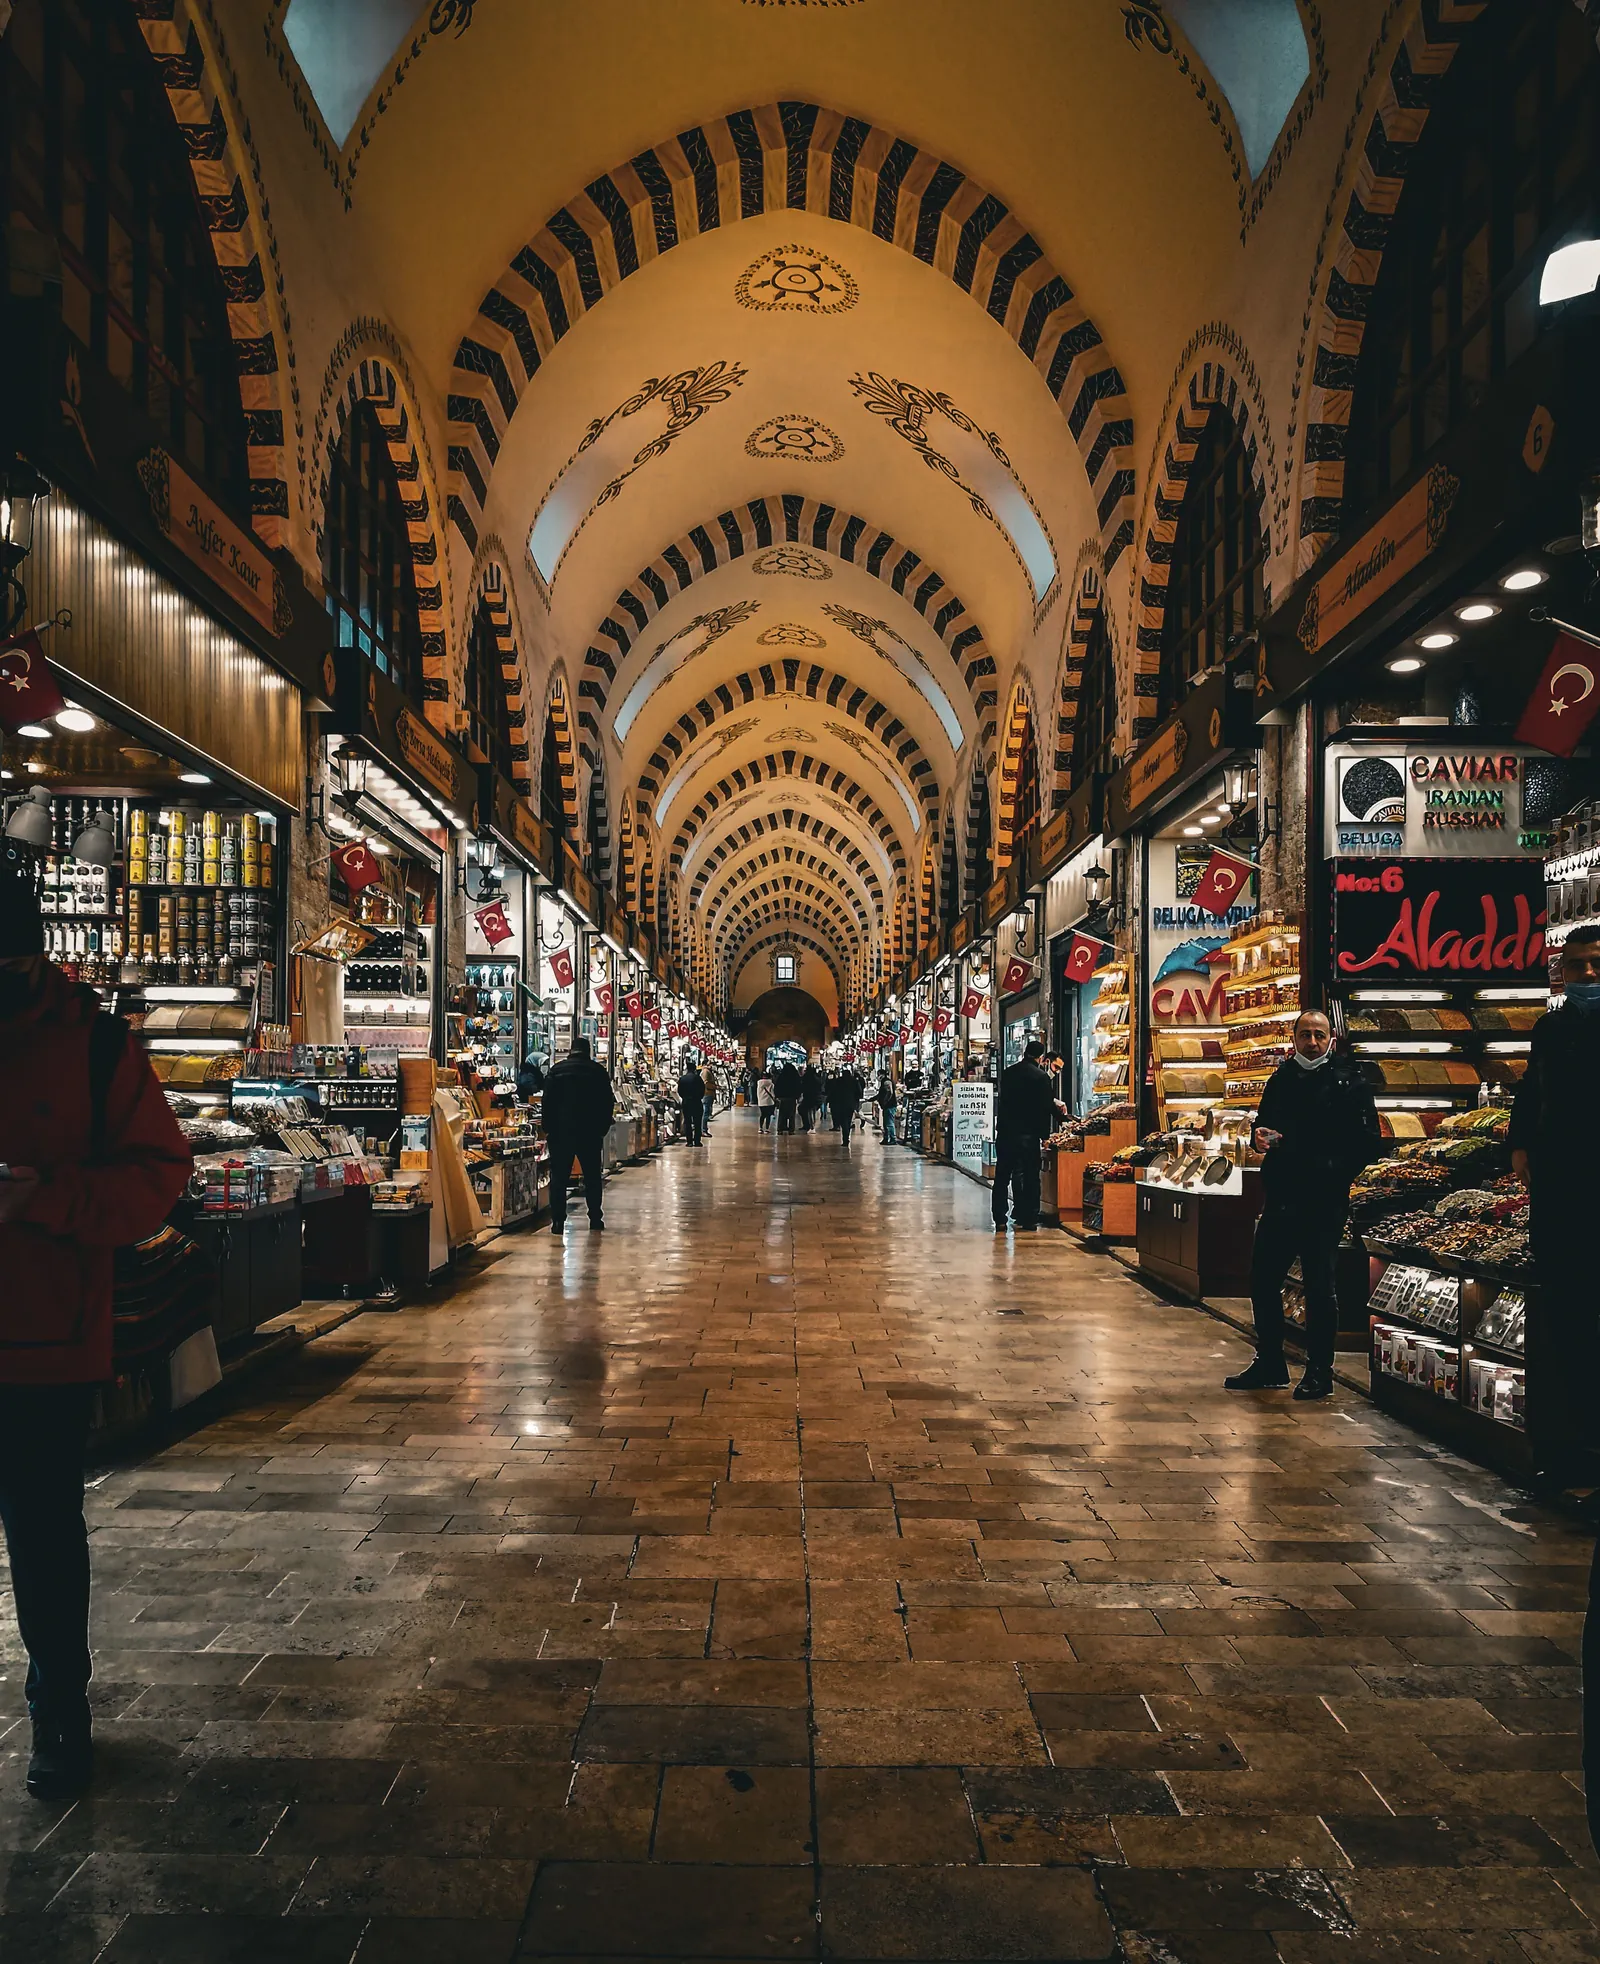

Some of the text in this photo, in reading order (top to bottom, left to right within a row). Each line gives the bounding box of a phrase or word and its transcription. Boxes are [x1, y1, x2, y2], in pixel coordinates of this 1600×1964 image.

[1532, 423, 1543, 456] 6
[185, 503, 226, 559] Ayfer
[1340, 536, 1396, 606] Aladdin
[1410, 755, 1518, 781] CAVIAR
[1425, 789, 1503, 806] IRANIAN
[1373, 806, 1404, 822] CAVIARS
[1423, 811, 1505, 827] RUSSIAN
[1340, 832, 1403, 846] BELUGA
[1336, 866, 1404, 893] No:6
